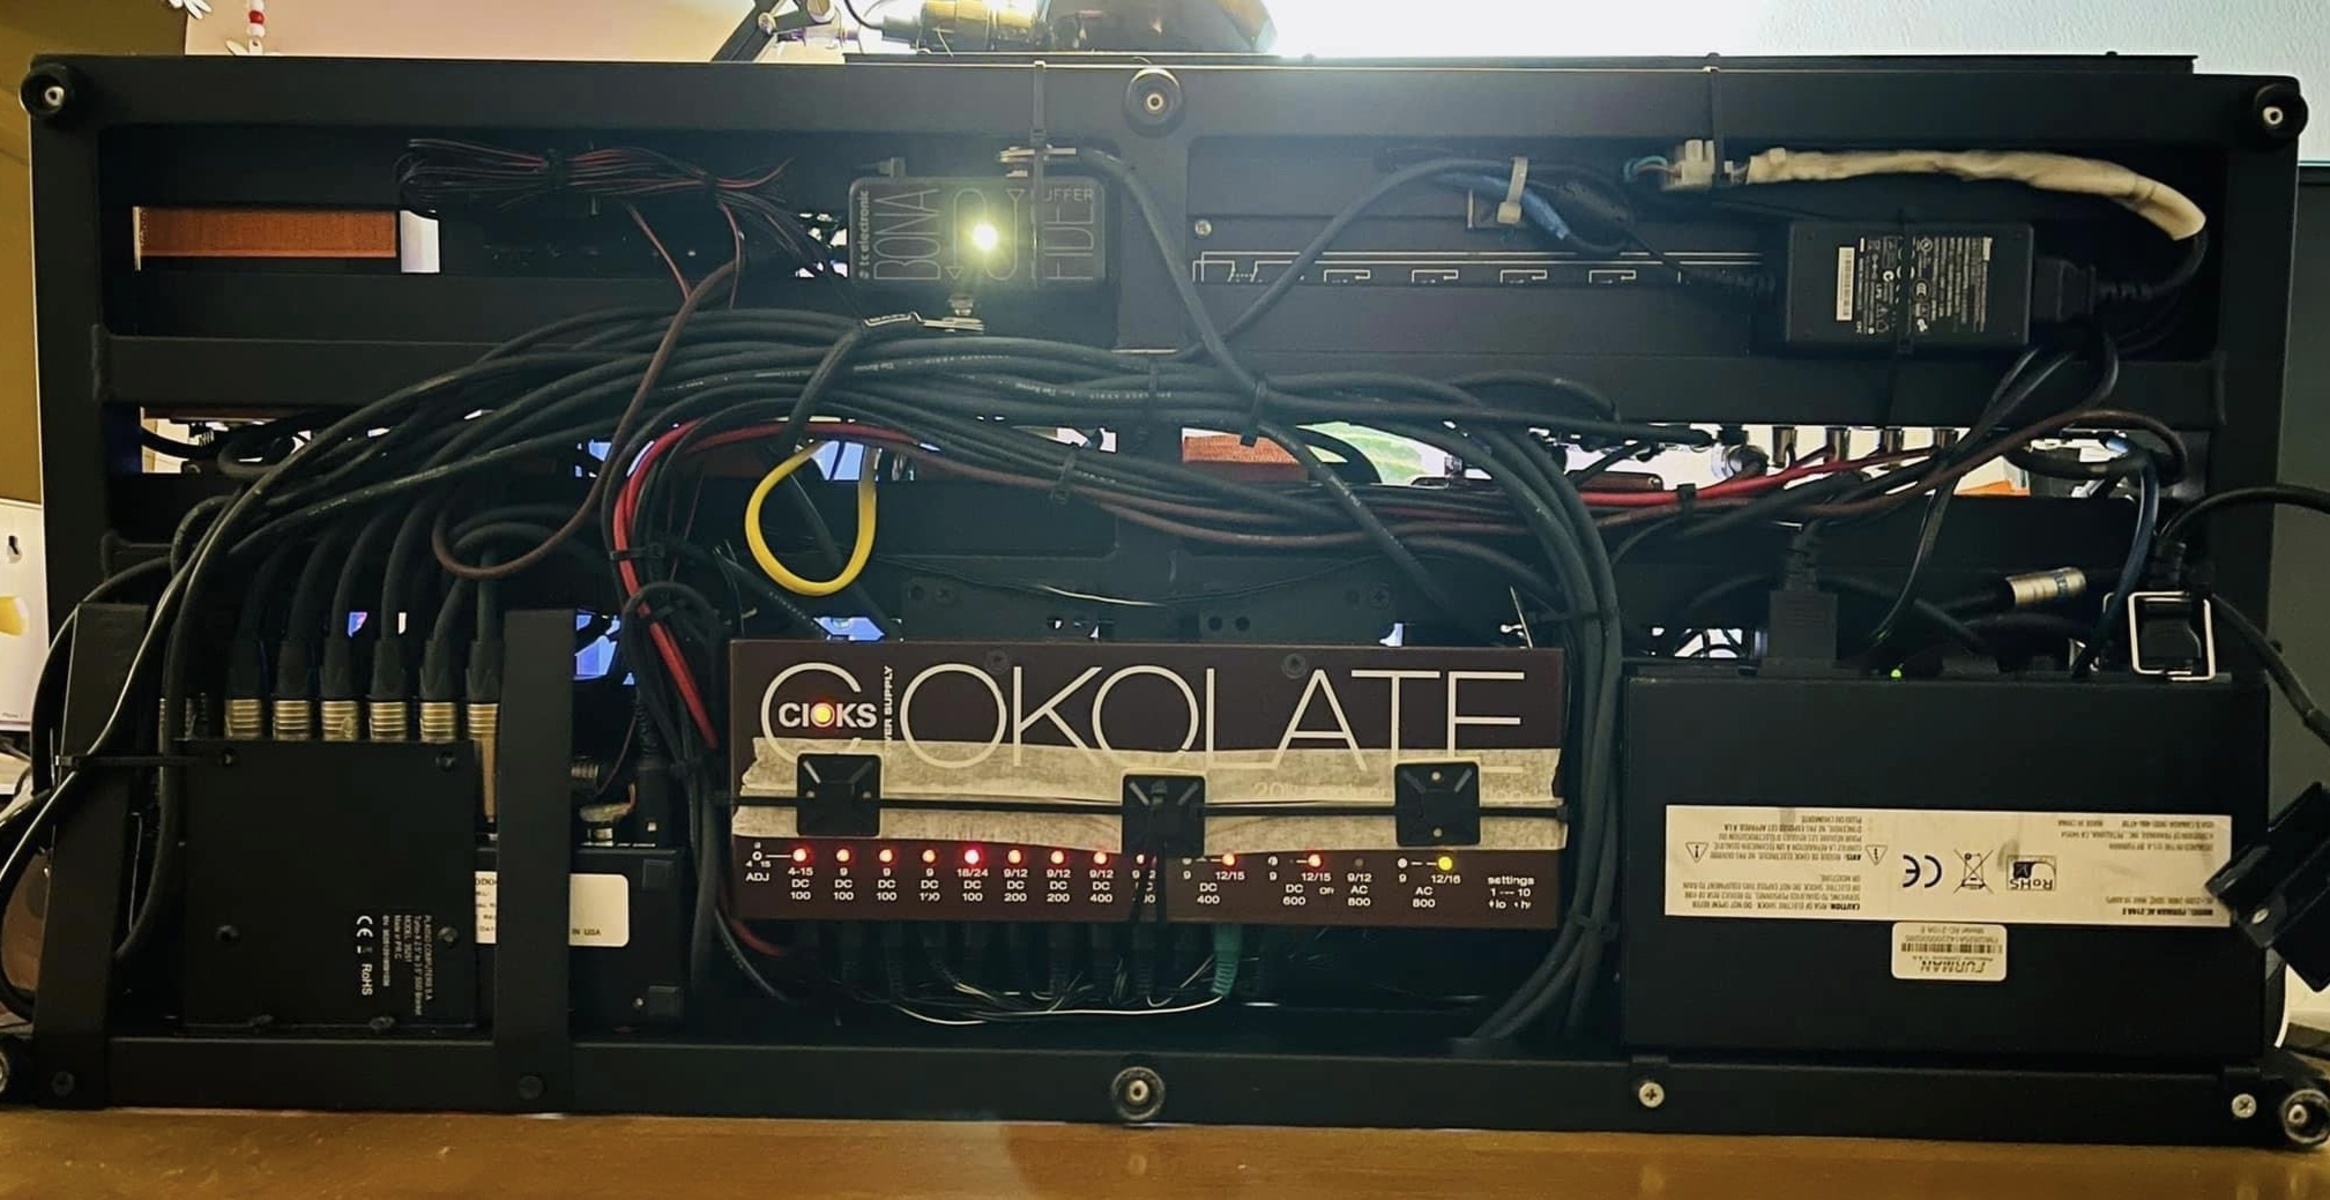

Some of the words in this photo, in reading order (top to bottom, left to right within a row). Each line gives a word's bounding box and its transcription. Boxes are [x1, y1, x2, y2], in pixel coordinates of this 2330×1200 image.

[1042, 188, 1094, 201] UFFER
[856, 190, 870, 253] electronic
[873, 187, 941, 281] BONA
[883, 665, 893, 715] SUPPLY
[778, 701, 878, 730] CIOKS
[788, 867, 813, 876] 4-15
[839, 867, 848, 877] 9
[883, 867, 891, 877] 9
[926, 867, 934, 877] 9
[1003, 868, 1028, 878] 9/12
[1046, 868, 1071, 878] 9/12
[1089, 869, 1114, 879] 9/12
[1215, 871, 1245, 881] 12/15
[1302, 871, 1332, 881] 12/15
[745, 872, 770, 882] ADJ
[1346, 872, 1372, 883] 9/12
[1488, 875, 1535, 887] settings
[791, 878, 810, 888] DC
[834, 879, 853, 889] DC
[877, 879, 896, 889] DC
[920, 879, 939, 889] DC
[963, 880, 982, 889] DC
[1006, 880, 1025, 890] DC
[1049, 880, 1068, 890] DC
[1092, 881, 1111, 891] DC
[1199, 882, 1218, 892] DC
[1285, 883, 1304, 893] DC
[2009, 878, 2054, 890] RoHS
[1350, 885, 1369, 895] AC
[1415, 886, 1434, 896] AC
[1517, 887, 1532, 897] 10
[790, 891, 812, 901] 100
[833, 891, 855, 901] 100
[876, 892, 898, 902] 100
[962, 892, 984, 902] 100
[1003, 892, 1028, 902] 200
[1046, 893, 1071, 903] 200
[1089, 893, 1113, 903] 400
[1196, 895, 1221, 905] 400
[1283, 896, 1306, 906] 600
[1921, 961, 1986, 973] FURMAN
[360, 963, 373, 997] RoHS
